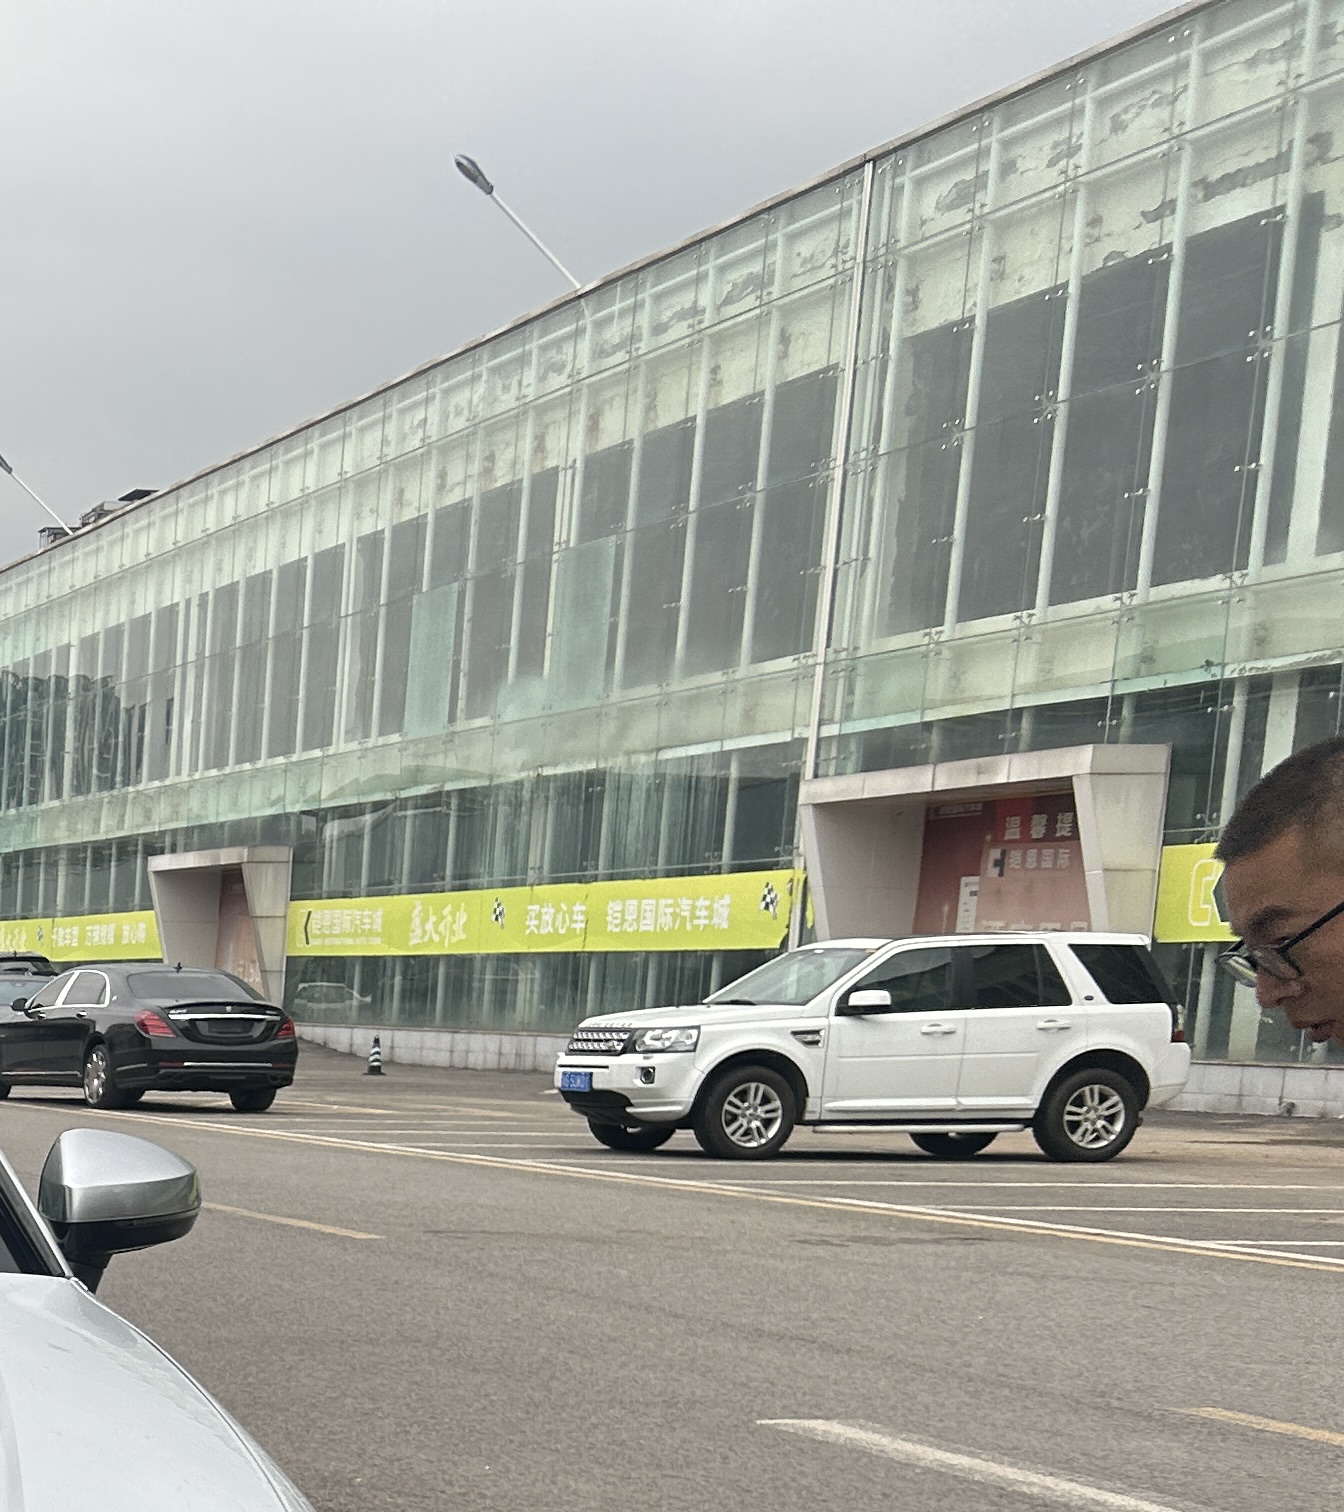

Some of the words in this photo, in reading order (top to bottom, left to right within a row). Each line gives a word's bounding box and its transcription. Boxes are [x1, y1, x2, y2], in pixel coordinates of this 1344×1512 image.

[525, 902, 587, 935] 买放心车
[606, 894, 732, 933] 铠恩国际汽车城
